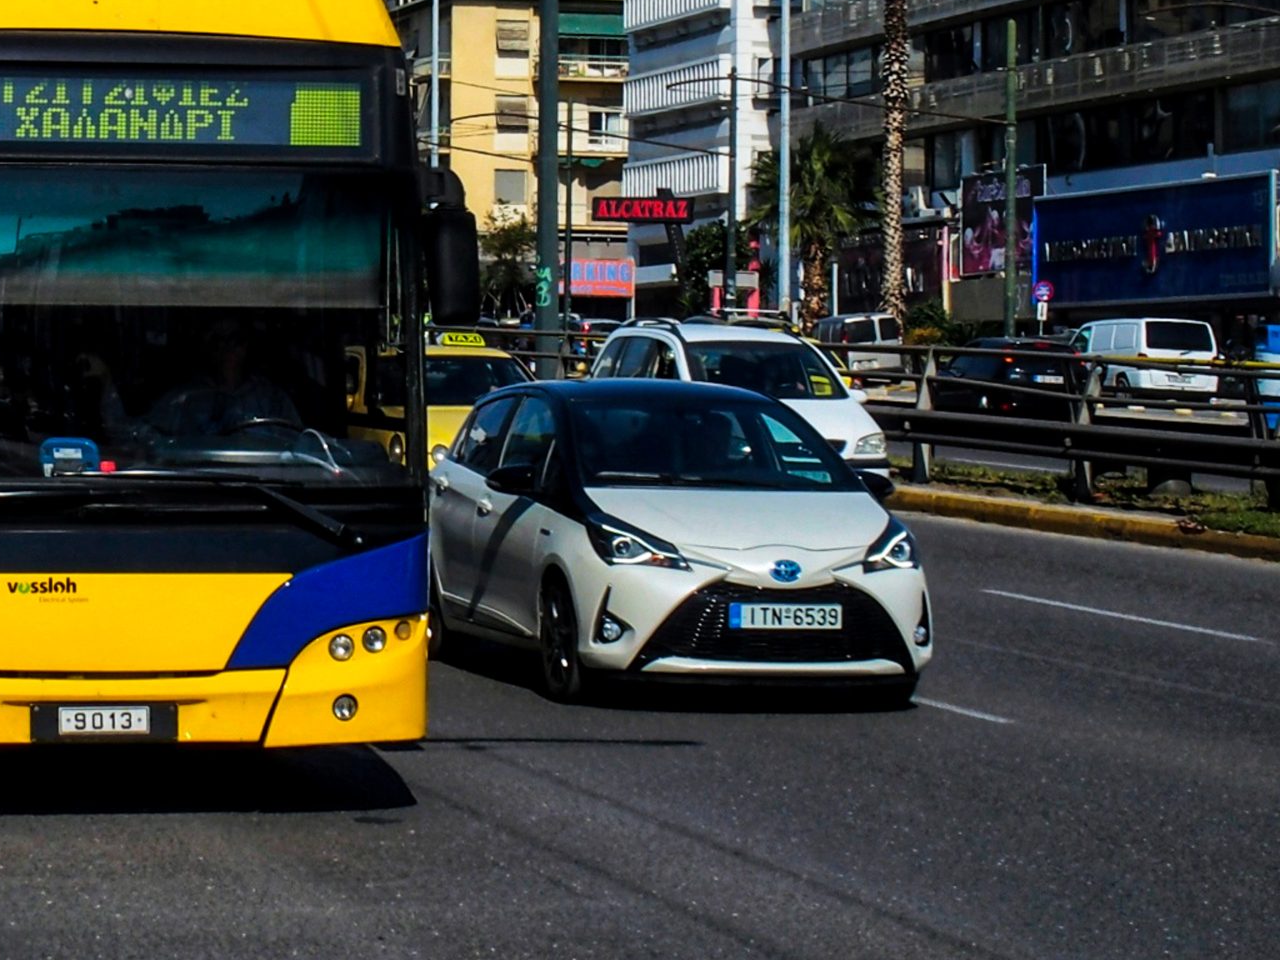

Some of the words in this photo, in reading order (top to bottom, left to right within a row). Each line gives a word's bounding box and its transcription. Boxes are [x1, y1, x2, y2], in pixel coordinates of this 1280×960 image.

[597, 200, 689, 219] ALCATRAZ
[571, 262, 630, 282] RKING
[7, 577, 77, 594] vossloh
[74, 712, 132, 730] 9013
